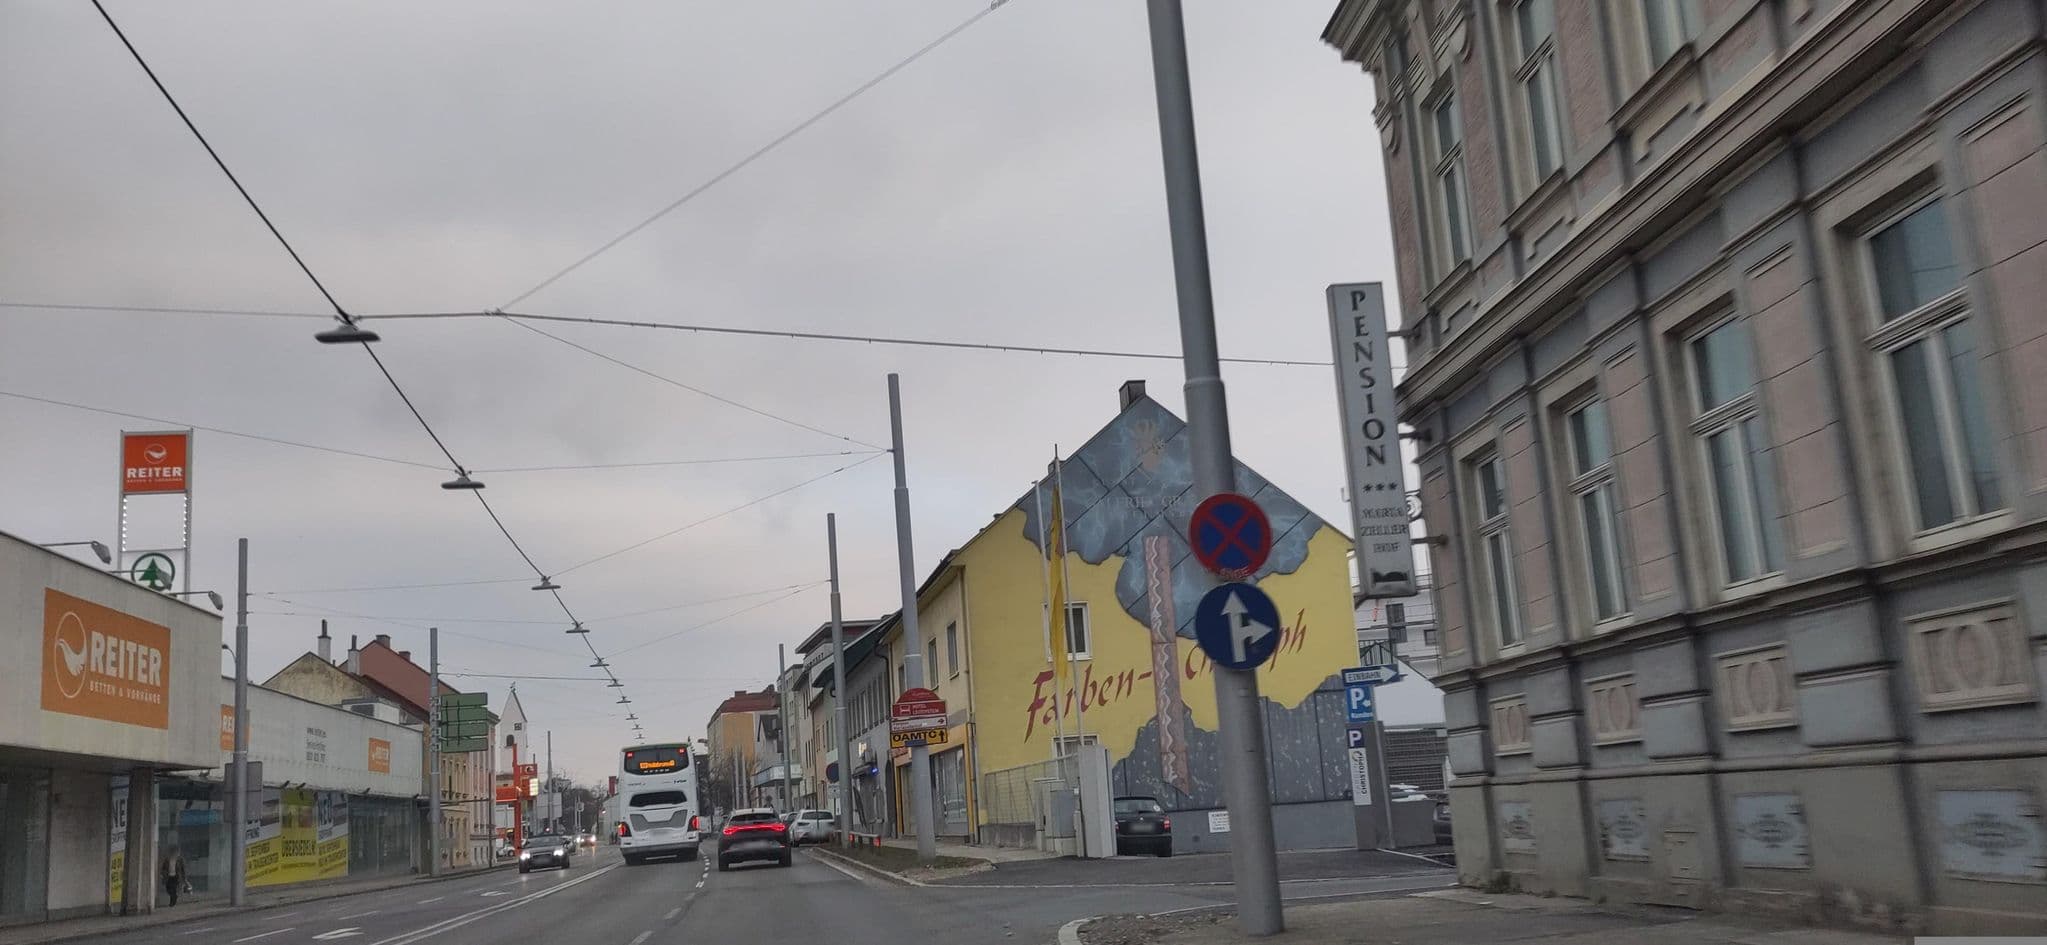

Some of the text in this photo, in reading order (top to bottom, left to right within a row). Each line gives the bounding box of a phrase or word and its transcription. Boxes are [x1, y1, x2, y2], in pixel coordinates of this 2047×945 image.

[1351, 290, 1386, 467] PENSION
[127, 467, 183, 478] REITER
[1360, 525, 1409, 537] ZELLER
[90, 631, 162, 688] REITER
[1348, 670, 1381, 682] EINBAHN
[1024, 663, 1153, 743] Farben-
[1350, 687, 1365, 710] P
[1348, 730, 1362, 747] P
